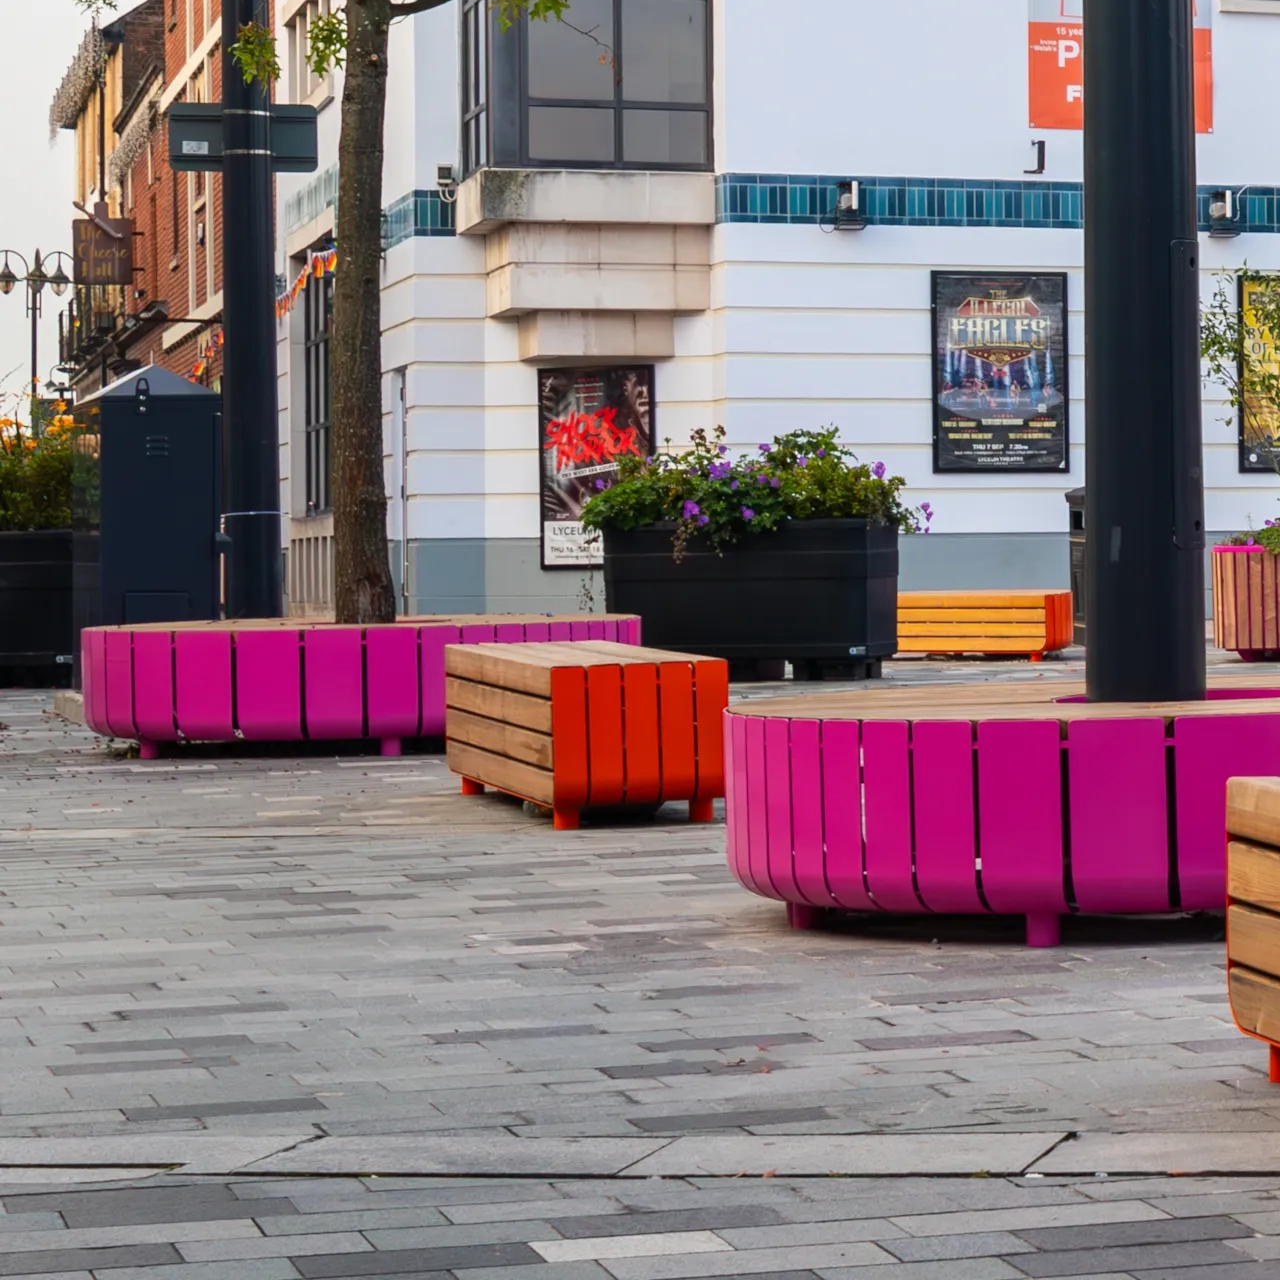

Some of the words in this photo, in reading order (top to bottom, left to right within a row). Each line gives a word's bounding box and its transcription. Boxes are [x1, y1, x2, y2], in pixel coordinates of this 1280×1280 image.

[1056, 26, 1067, 36] 15
[1068, 28, 1084, 37] yea
[989, 289, 1008, 299] THE
[969, 300, 1031, 316] ILLEGAL
[951, 318, 1046, 350] EAGLES
[1247, 328, 1265, 340] BY
[1251, 343, 1270, 355] OF
